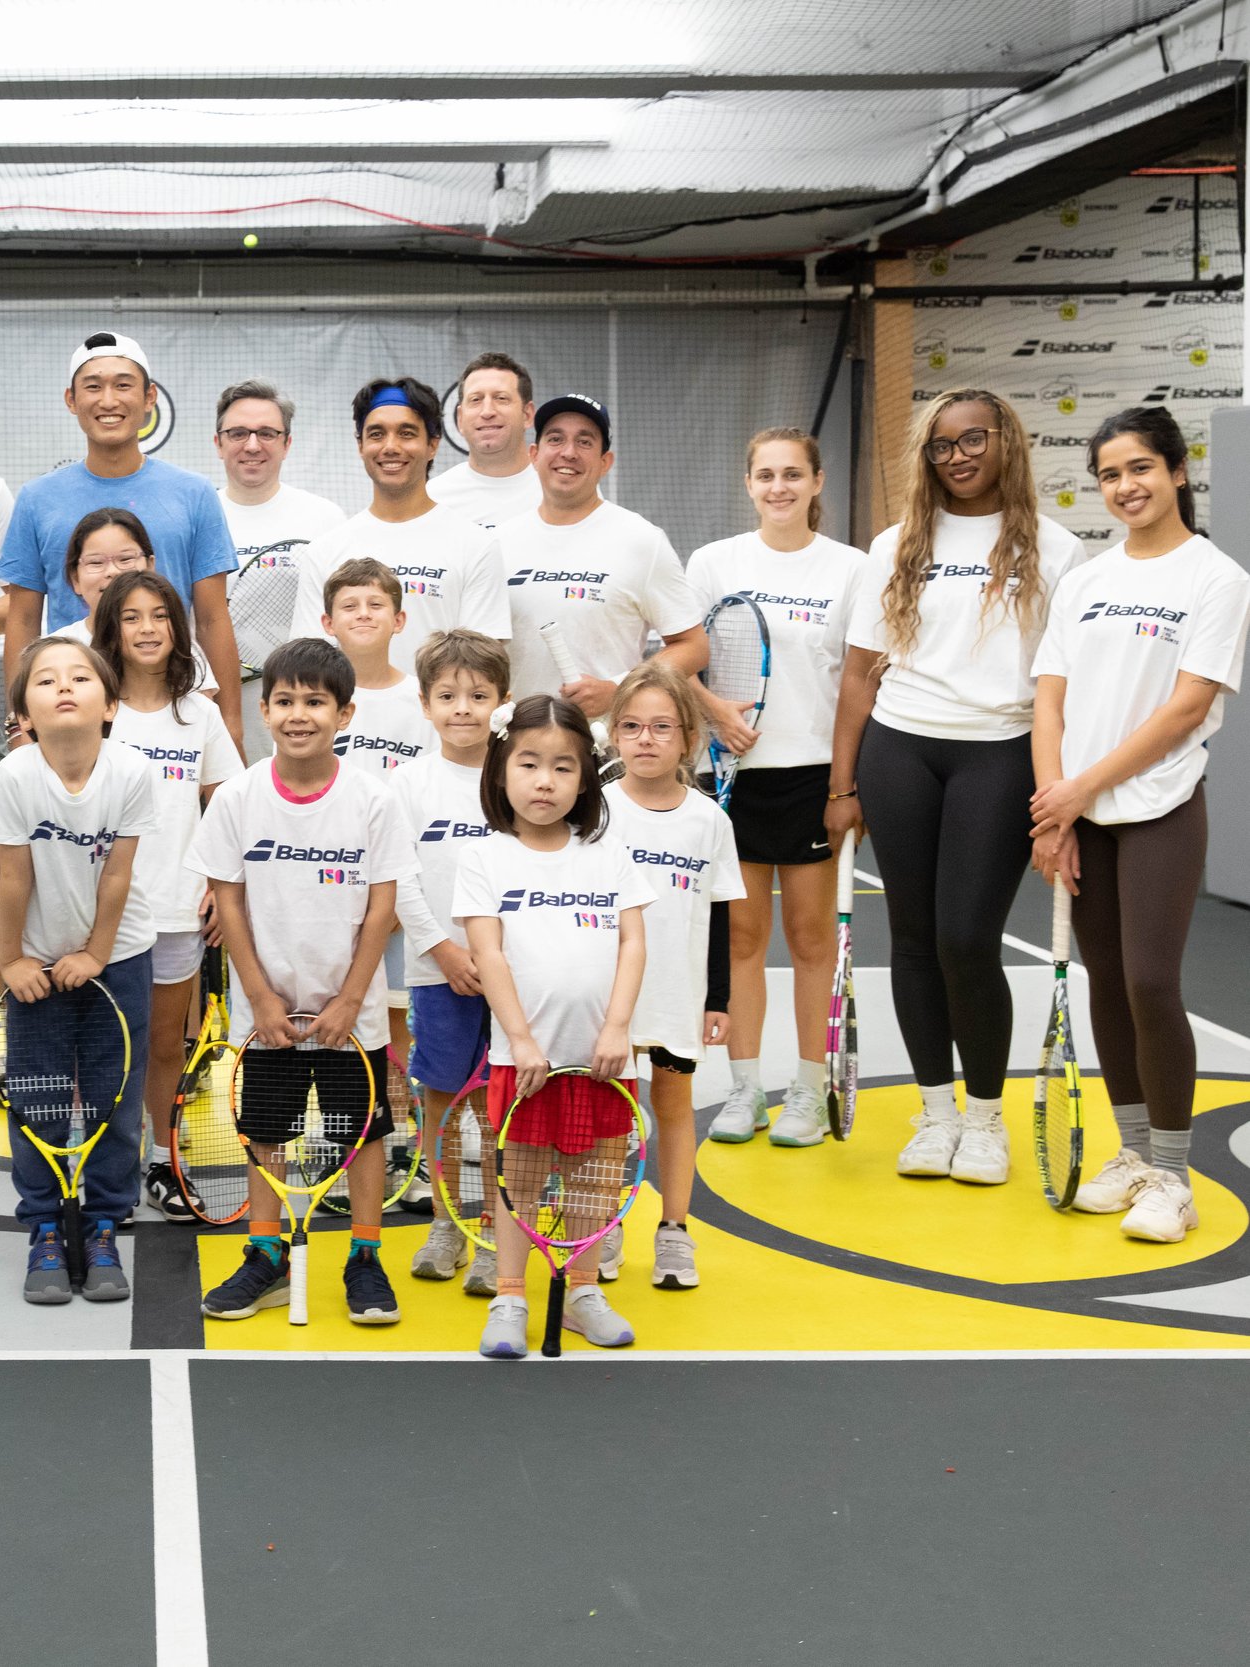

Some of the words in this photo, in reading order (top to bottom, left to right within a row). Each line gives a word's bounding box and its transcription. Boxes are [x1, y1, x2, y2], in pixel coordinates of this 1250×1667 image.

[404, 581, 426, 594] 150
[564, 587, 585, 599] 150
[788, 609, 811, 622] 150
[1135, 622, 1159, 637] 150
[162, 766, 184, 780] 150
[318, 869, 345, 884] 150
[573, 912, 599, 928] 150
